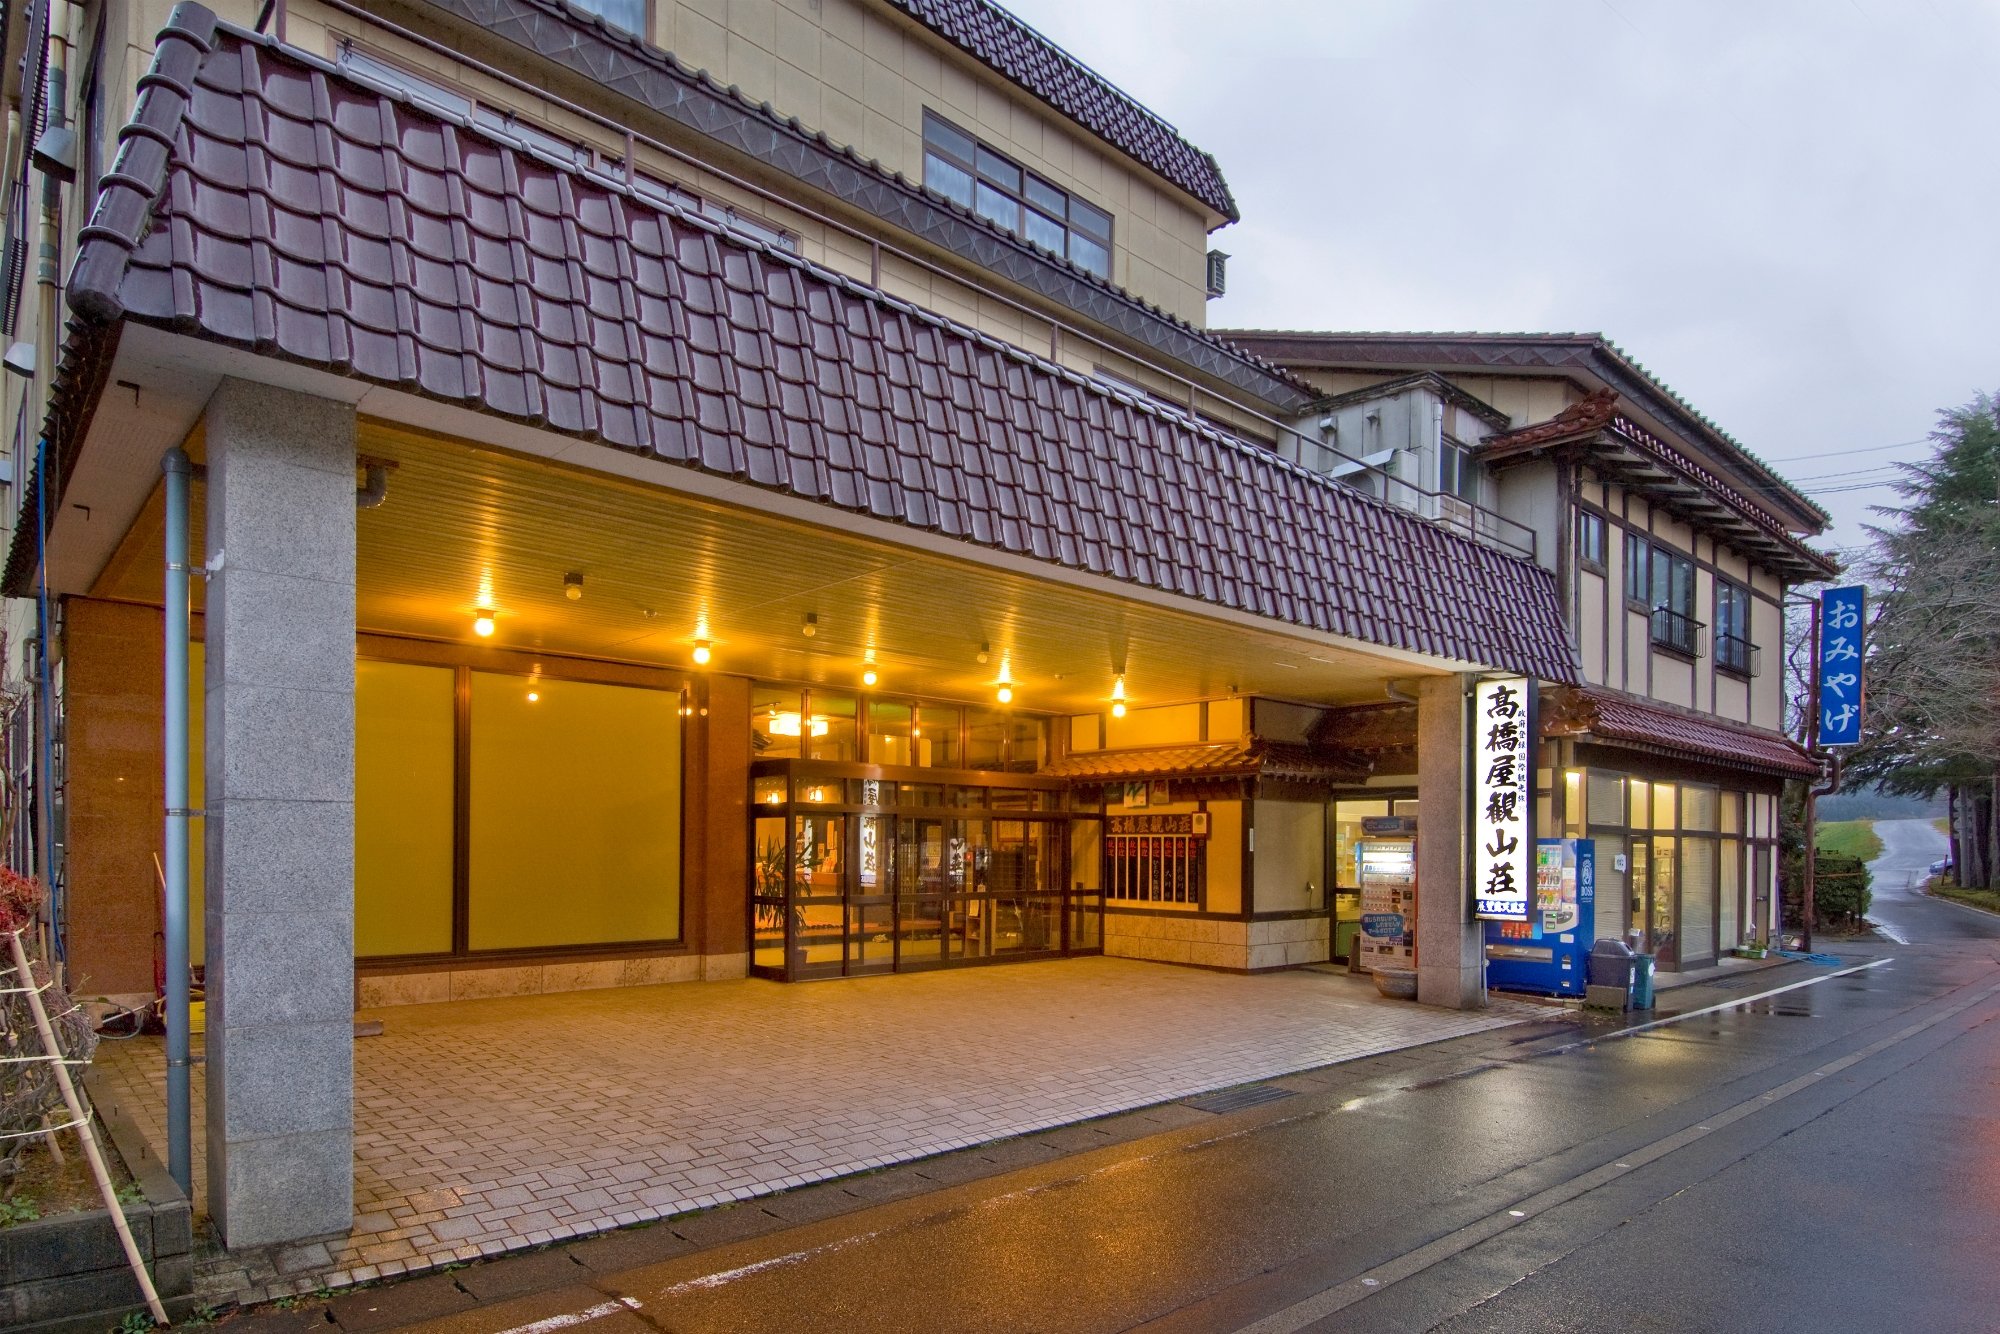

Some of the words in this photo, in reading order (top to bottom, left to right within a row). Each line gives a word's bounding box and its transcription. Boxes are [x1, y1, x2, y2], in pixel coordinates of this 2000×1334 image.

[1823, 599, 1859, 734] おみやげ
[1518, 709, 1526, 813] 政府登録国際観光旅
[1581, 886, 1593, 897] BOSS
